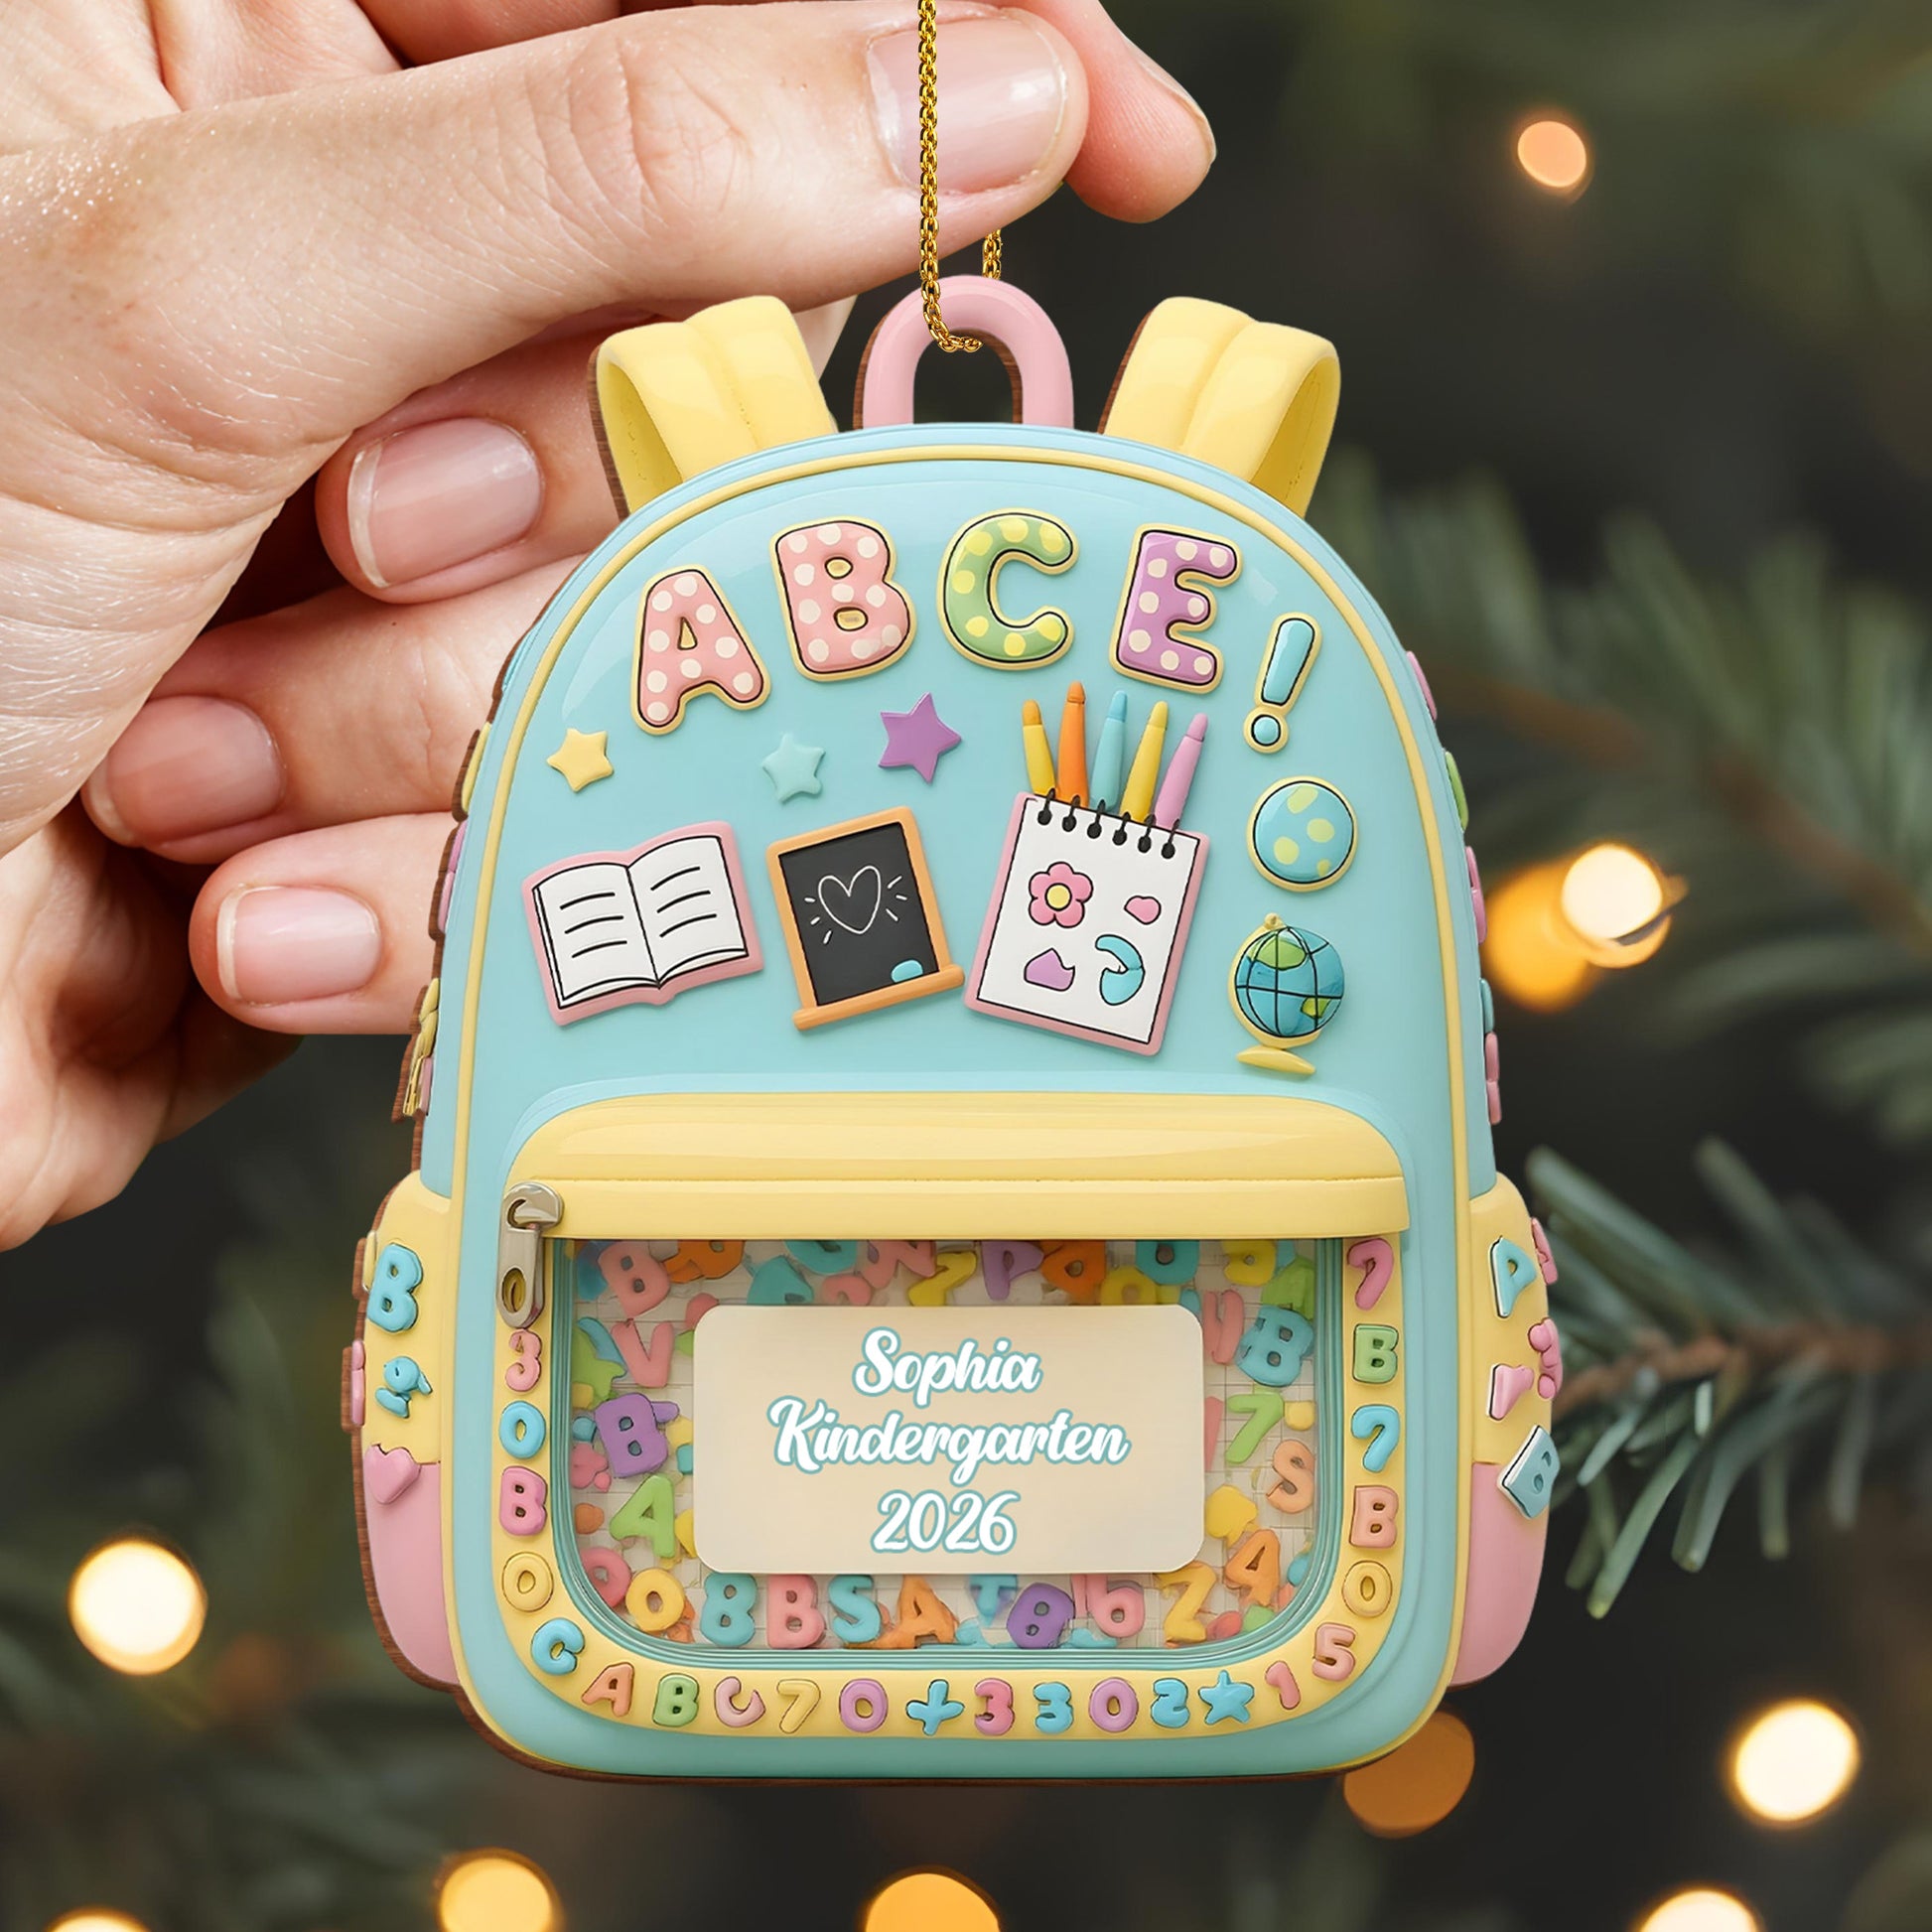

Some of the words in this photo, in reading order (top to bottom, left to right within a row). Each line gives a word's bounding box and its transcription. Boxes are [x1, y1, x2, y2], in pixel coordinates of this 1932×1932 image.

[853, 1326, 1043, 1407] Sophia
[766, 1396, 1131, 1486] Kindergarten
[871, 1489, 1021, 1554] 2026
